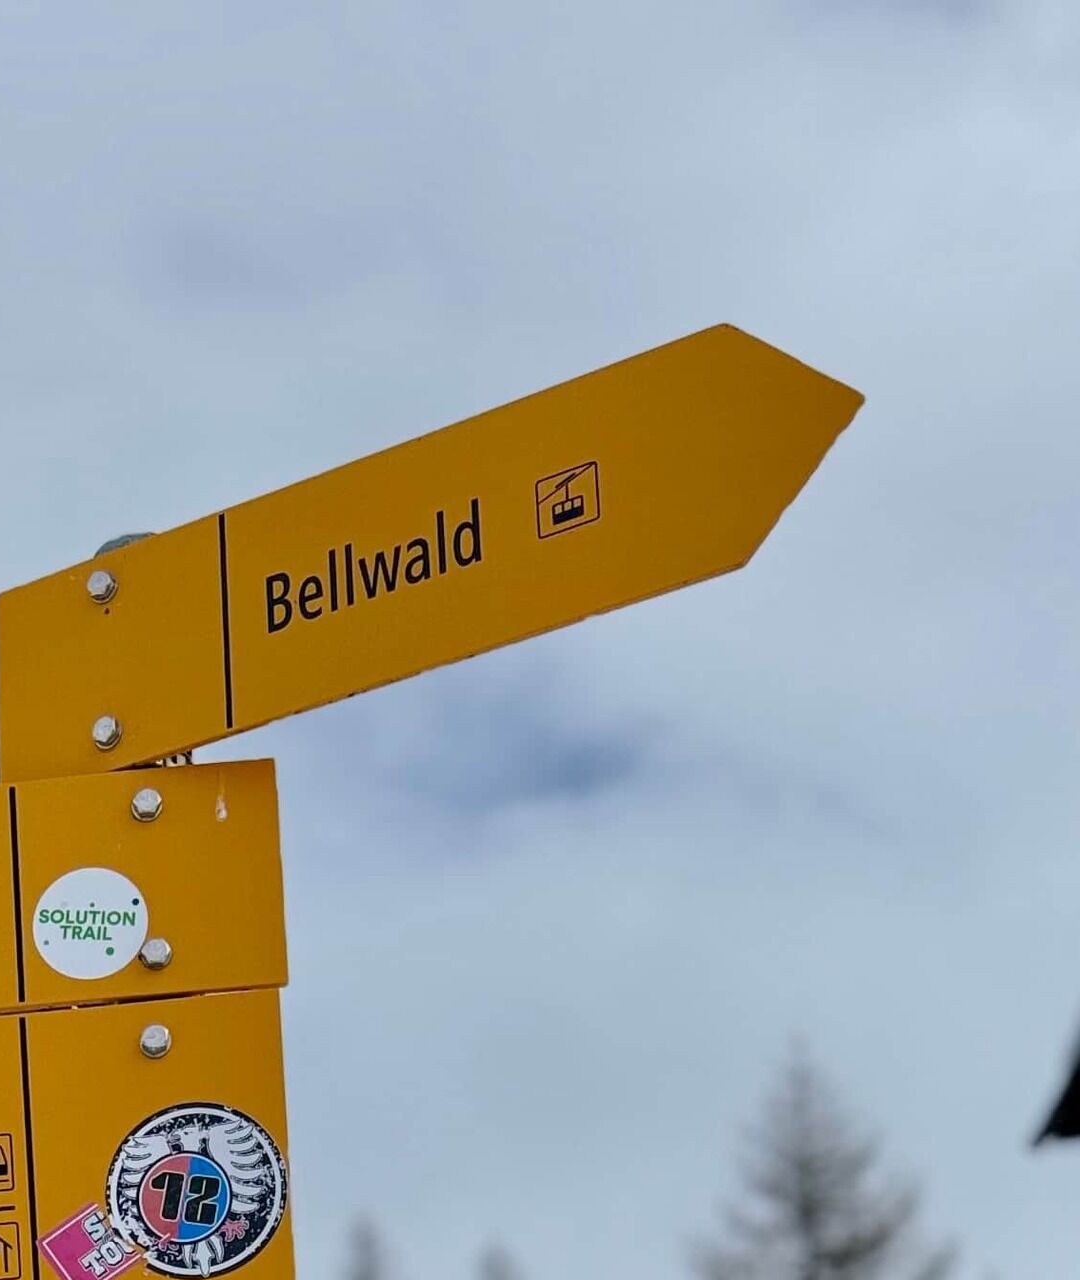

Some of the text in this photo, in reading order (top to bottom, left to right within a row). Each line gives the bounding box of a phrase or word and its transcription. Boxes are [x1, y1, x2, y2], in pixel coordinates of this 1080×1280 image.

[265, 498, 483, 635] Bellwald
[39, 909, 136, 926] SOLUTION
[60, 925, 112, 940] TRAIL
[149, 1170, 221, 1226] 12
